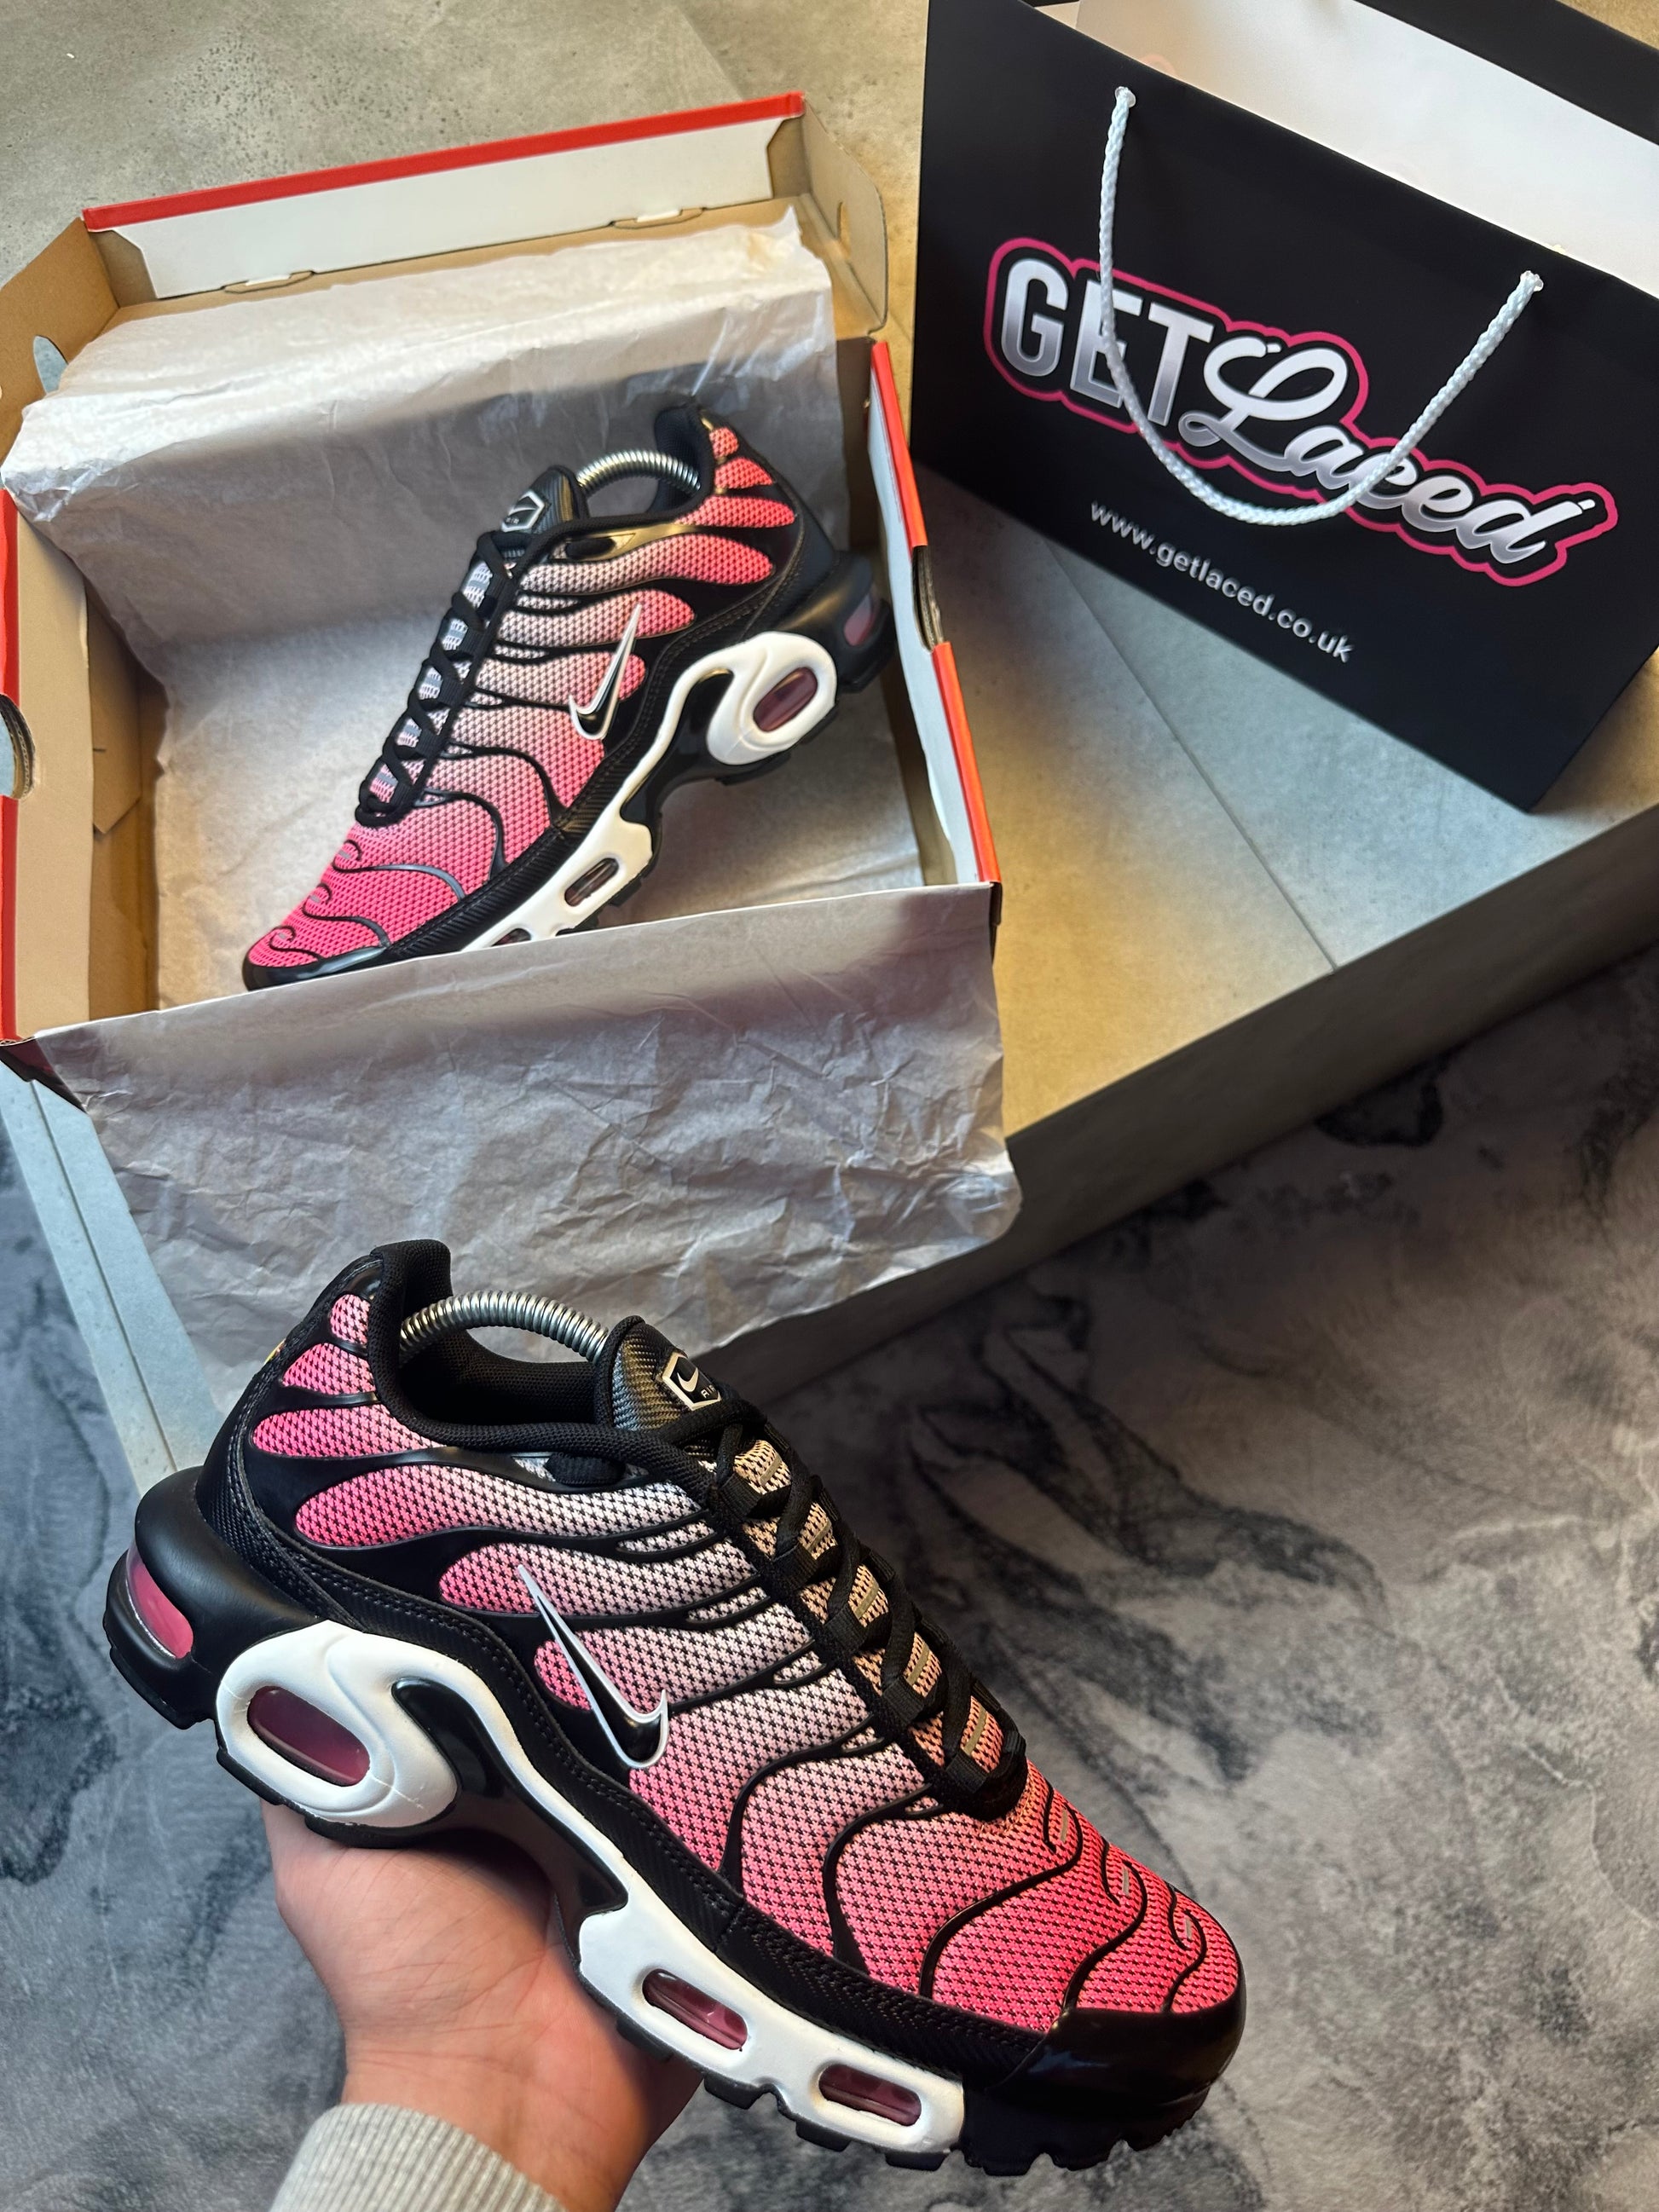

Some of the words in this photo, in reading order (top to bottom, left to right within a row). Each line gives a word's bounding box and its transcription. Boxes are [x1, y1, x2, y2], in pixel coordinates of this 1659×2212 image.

[1001, 258, 1214, 426] GET
[1178, 338, 1595, 564] Laced
[1090, 501, 1355, 663] www.getlaced.co.uk
